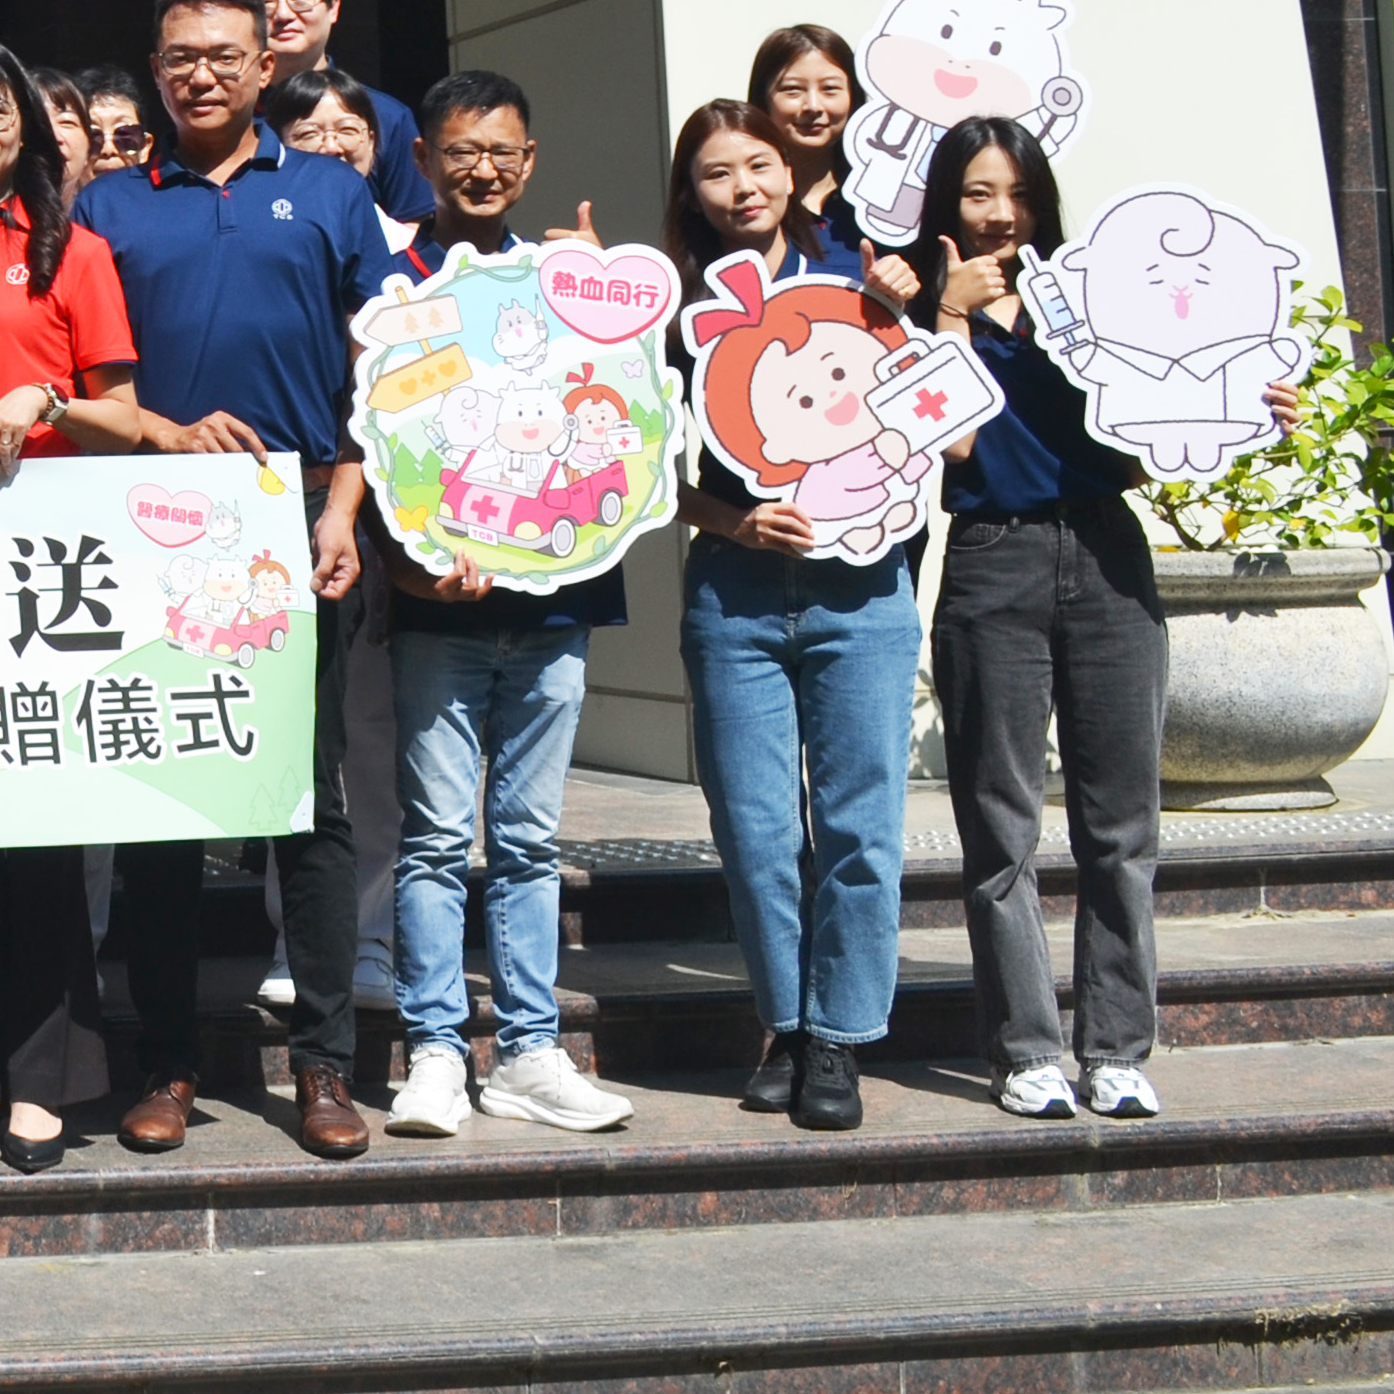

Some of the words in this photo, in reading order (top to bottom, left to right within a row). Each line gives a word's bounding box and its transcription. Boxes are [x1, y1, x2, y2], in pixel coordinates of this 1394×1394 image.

[551, 270, 659, 309] 熱血同行
[472, 529, 494, 542] TCB
